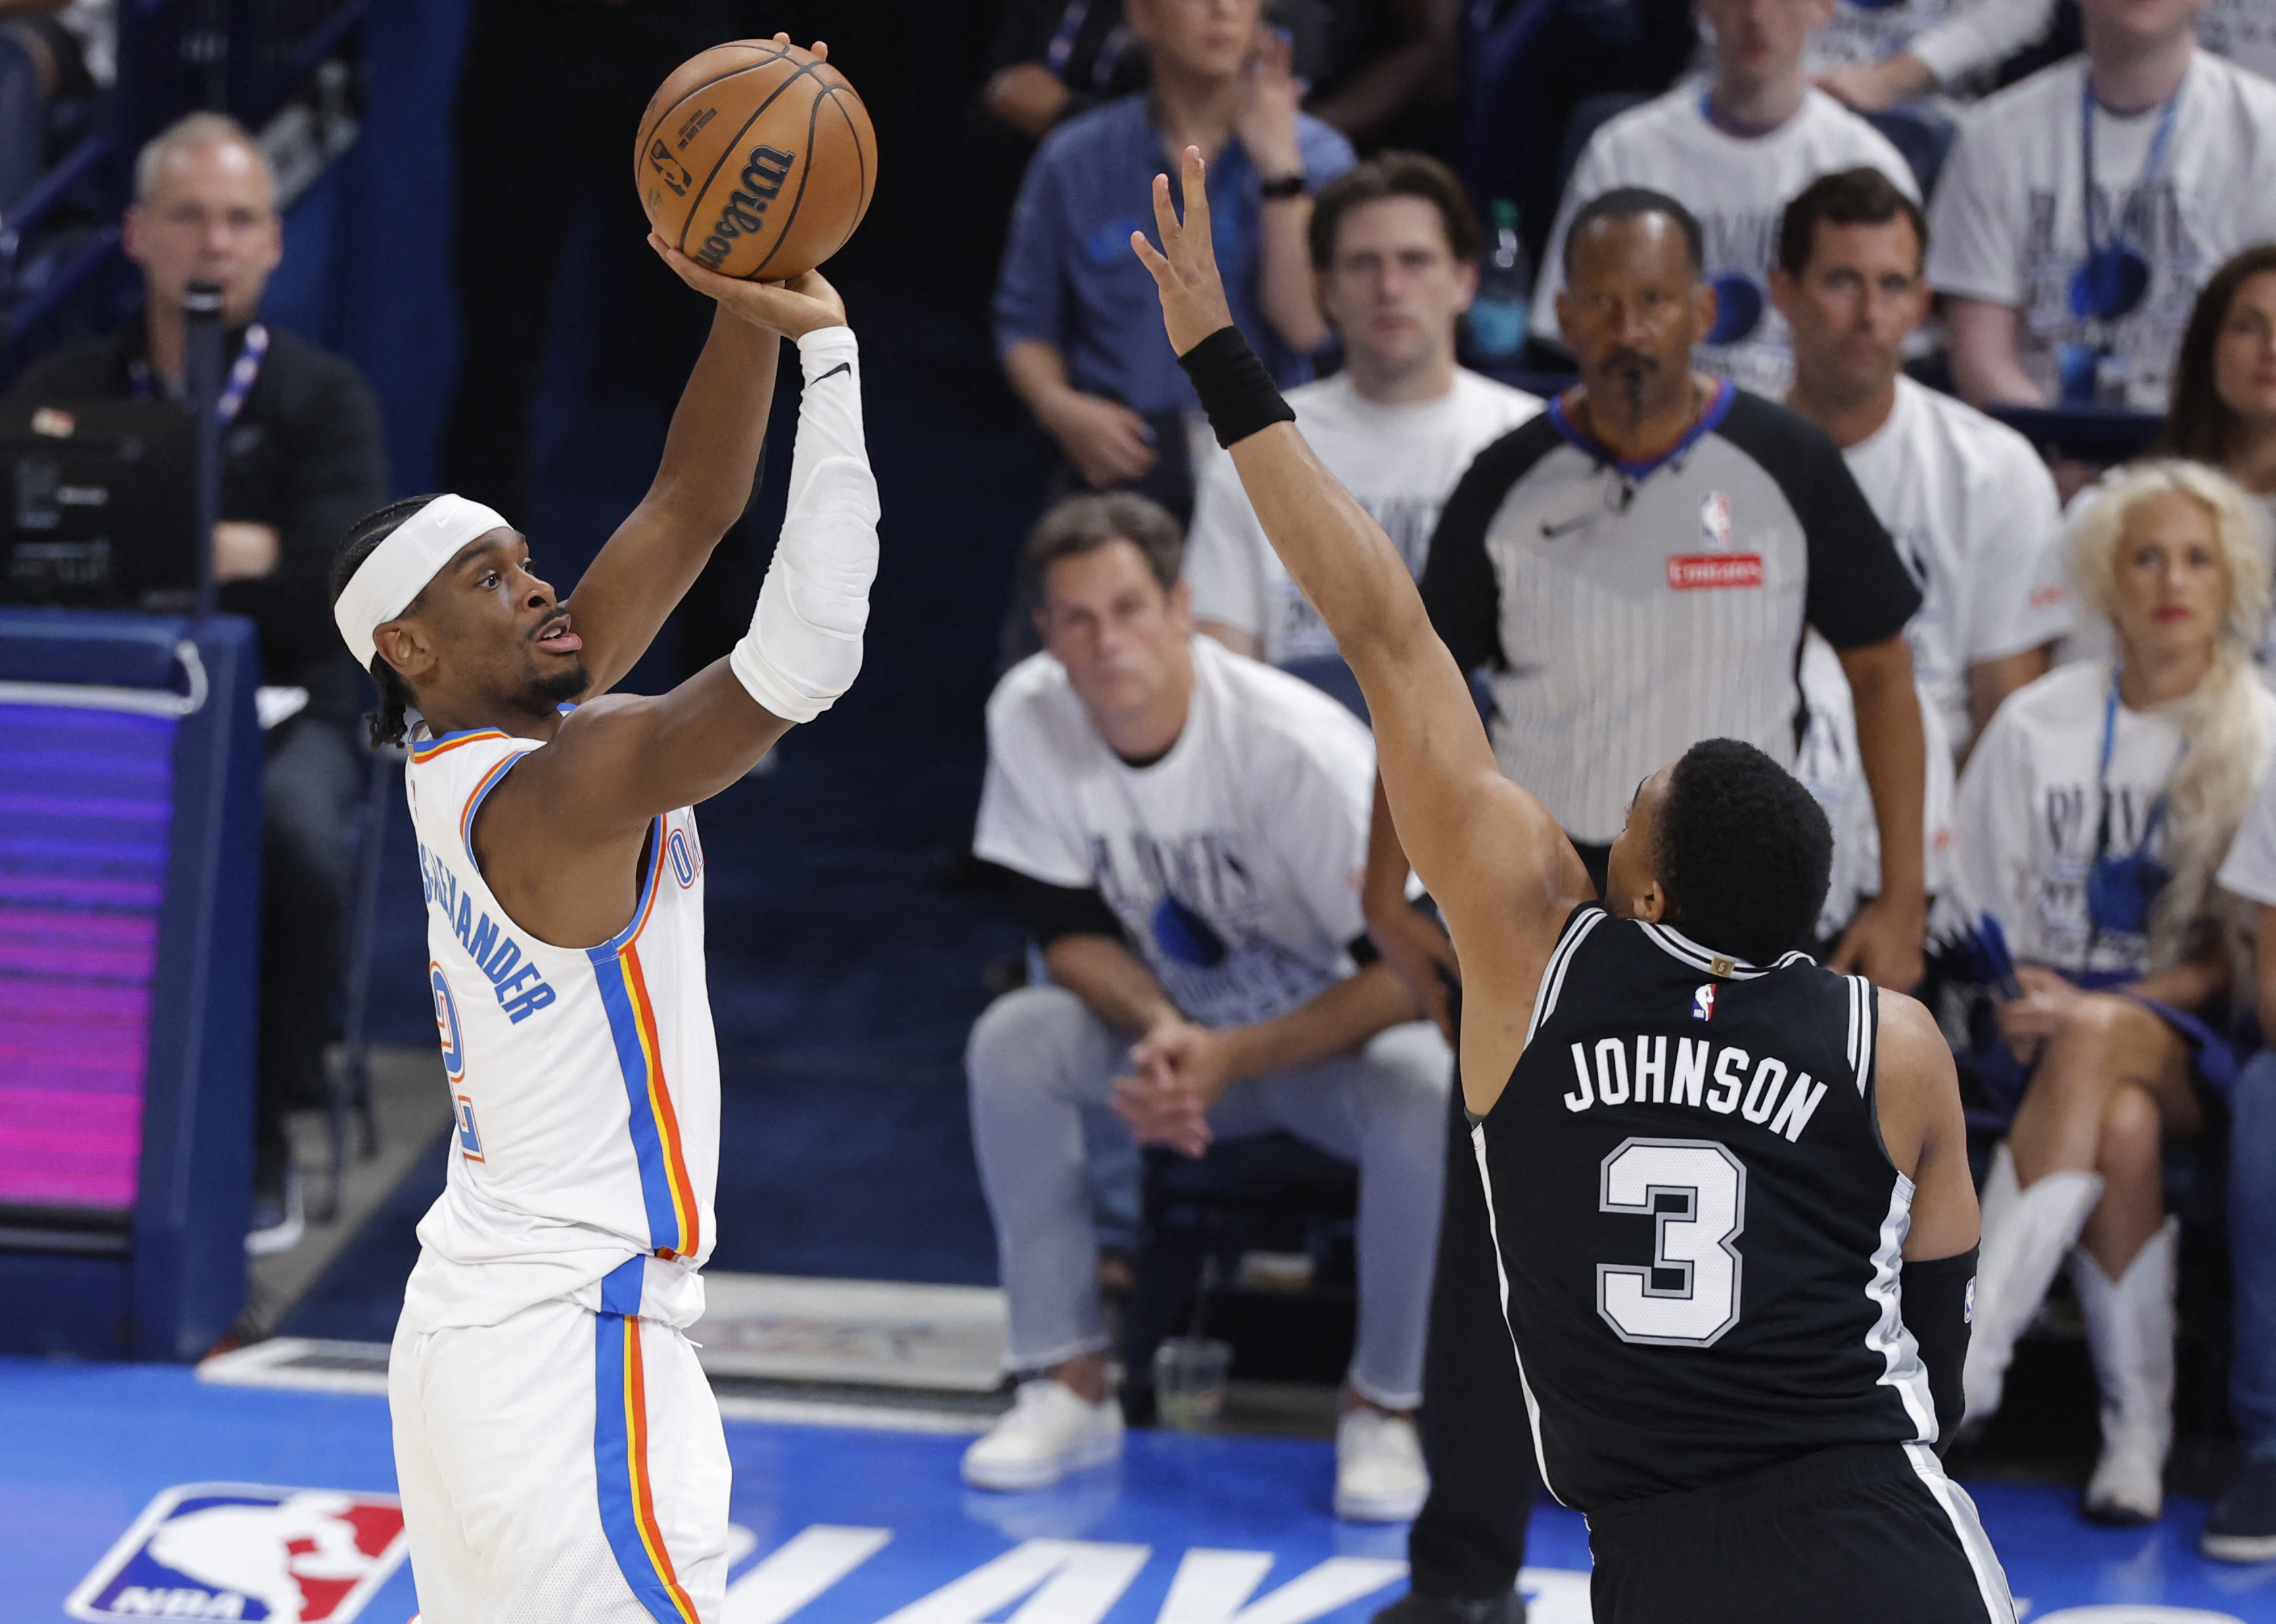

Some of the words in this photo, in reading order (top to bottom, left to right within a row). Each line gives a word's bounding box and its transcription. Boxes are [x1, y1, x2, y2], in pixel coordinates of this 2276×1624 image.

[695, 145, 796, 270] Wilson
[429, 960, 486, 1164] 2
[1693, 1008, 1705, 1019] NBA
[1564, 1034, 1828, 1144] JOHNSON
[1596, 1136, 1748, 1348] 3
